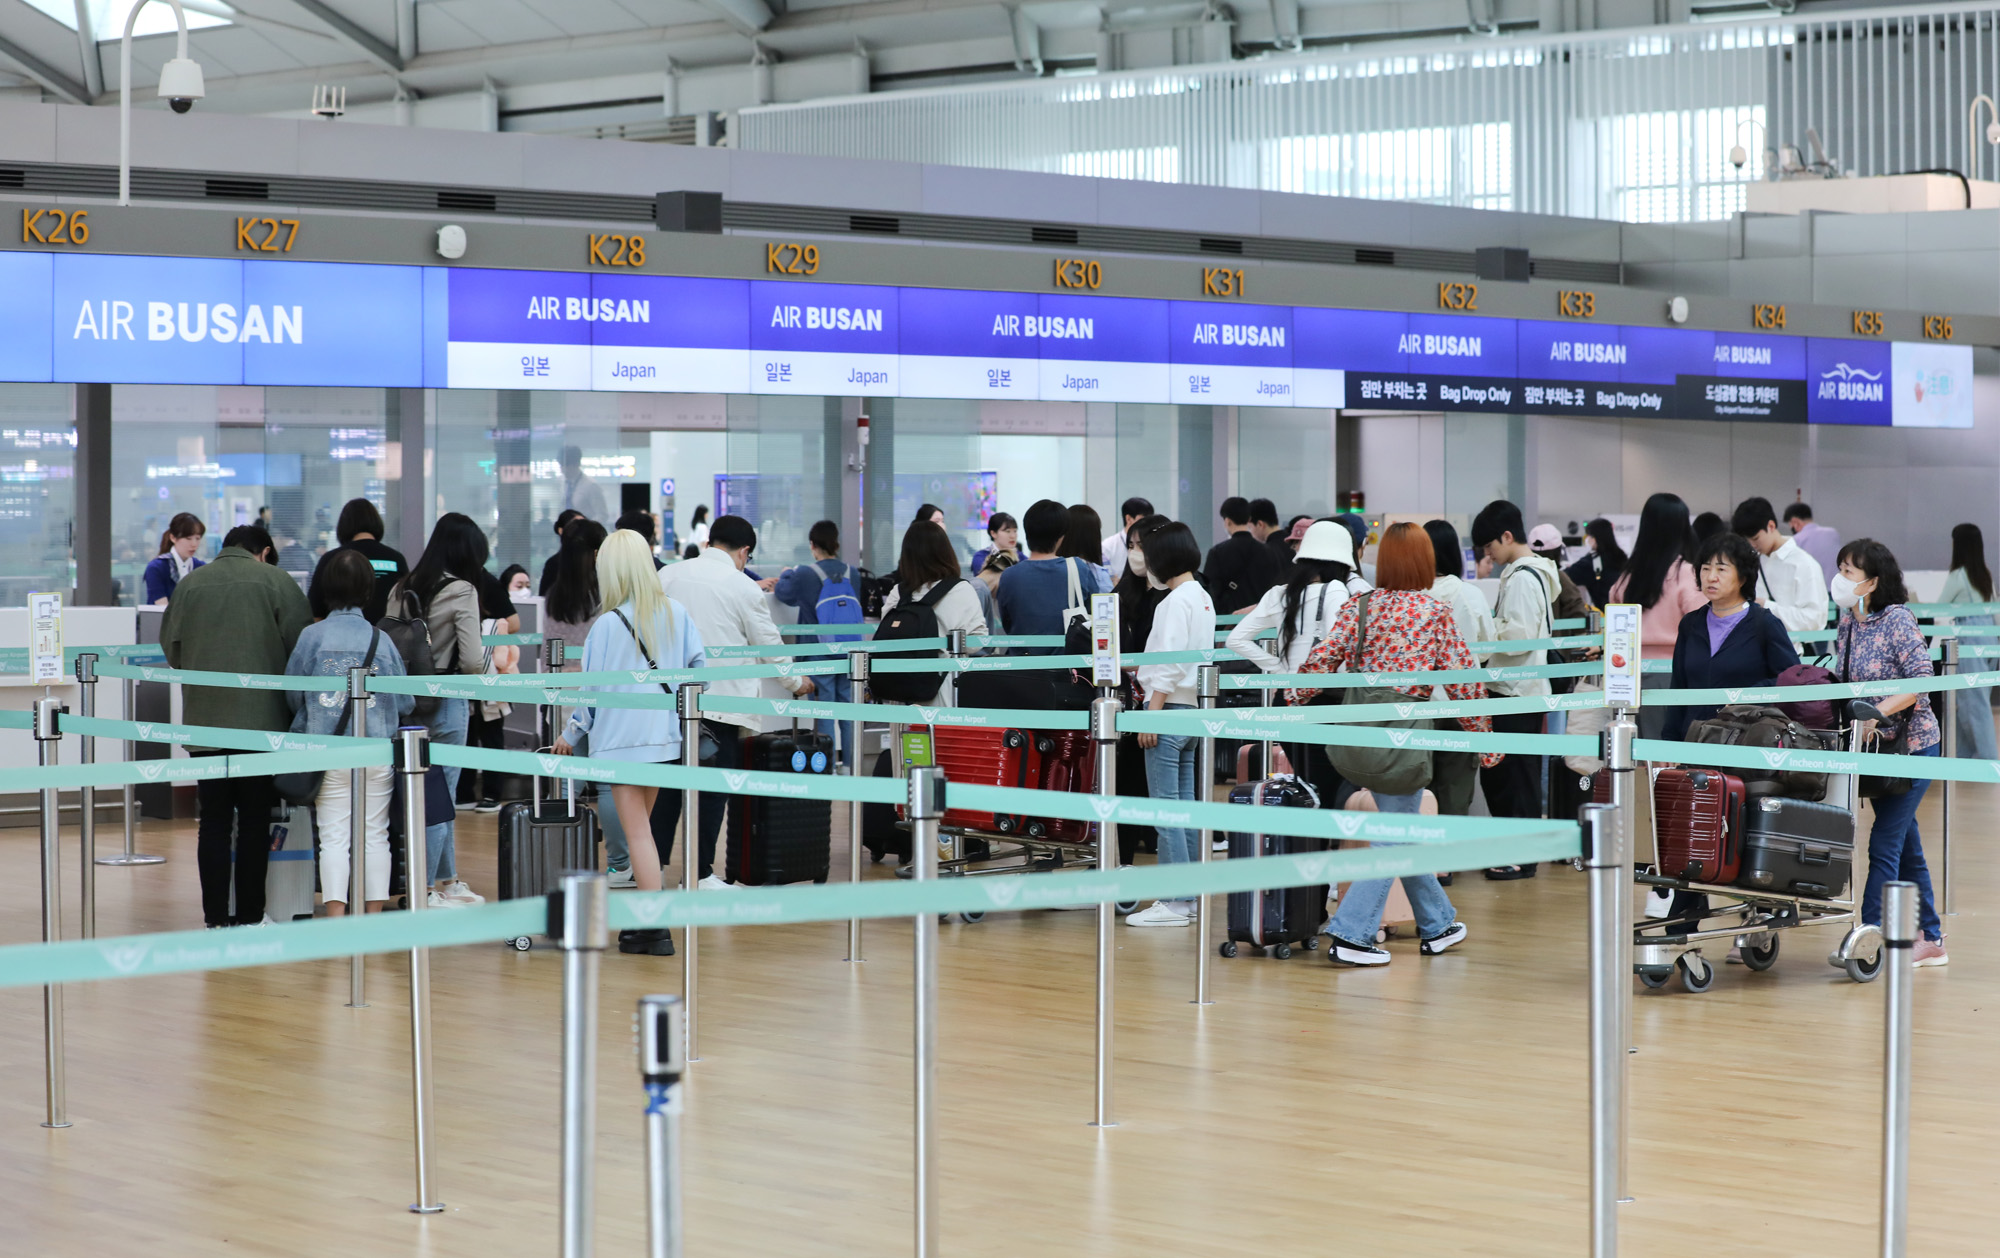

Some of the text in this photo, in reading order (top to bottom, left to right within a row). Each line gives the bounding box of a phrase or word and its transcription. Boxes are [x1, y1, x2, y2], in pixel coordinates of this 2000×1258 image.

[22, 208, 90, 245] K26
[236, 216, 300, 252] K27
[589, 233, 647, 267] K28
[768, 242, 820, 275] K29
[1055, 258, 1103, 289] K30
[1204, 267, 1244, 297] K31
[1439, 281, 1478, 311] K32
[1559, 290, 1596, 318] K33
[527, 296, 650, 323] AIR BUSAN
[770, 305, 882, 331] AIR BUSAN
[1754, 303, 1787, 329] K34
[73, 300, 303, 344] AIR BUSAN
[992, 314, 1094, 339] AIR BUSAN
[1853, 310, 1884, 335] K35
[1924, 315, 1953, 339] K36
[1193, 323, 1285, 347] AIR BUSAN
[1398, 333, 1482, 357] AIR BUSAN
[1550, 342, 1627, 364] AIR BUSAN
[1713, 345, 1771, 365] AIR BUSAN
[521, 356, 550, 377] 일본
[612, 361, 656, 381] Japan
[765, 362, 792, 382] 일본
[848, 368, 888, 387] Japan
[987, 369, 1011, 388] 일본
[1062, 374, 1099, 392] Japan
[1189, 375, 1211, 393] 일본
[1256, 380, 1290, 397] Japan
[1361, 380, 1427, 401] 짐만 부치는 곳
[1440, 385, 1511, 405] Bag Drop Only
[1524, 386, 1585, 406] 짐만 부치는 곳
[1818, 381, 1883, 402] AIR BUSAN
[1596, 391, 1662, 411] Bag Drop Only
[793, 665, 835, 674] Incheon Airport
[994, 661, 1011, 669] Airport
[1521, 670, 1538, 678] Airport
[524, 679, 546, 687] Airport
[674, 673, 694, 682] Airport
[1271, 679, 1290, 687] Airport
[440, 687, 476, 697] Incheon Airport
[579, 697, 597, 705] Airport
[1762, 692, 1780, 701] Airport
[789, 706, 833, 717] Incheon Airport
[1414, 707, 1460, 716] Incheon Airport
[1561, 698, 1603, 707] Incheon Airport
[938, 714, 986, 724] Incheon Airport
[152, 730, 191, 742] Incheon Airport
[1225, 727, 1280, 738] Incheon Airport
[284, 741, 306, 750] Incheon
[1411, 737, 1470, 749] Incheon Airport
[167, 764, 241, 777] Incheon Airport
[560, 764, 615, 779] Incheon Airport
[1789, 757, 1858, 771] Incheon Airport
[747, 780, 808, 795] Incheon Airport
[1118, 807, 1191, 824] Incheon Airport
[1364, 822, 1447, 839] Incheon Airport
